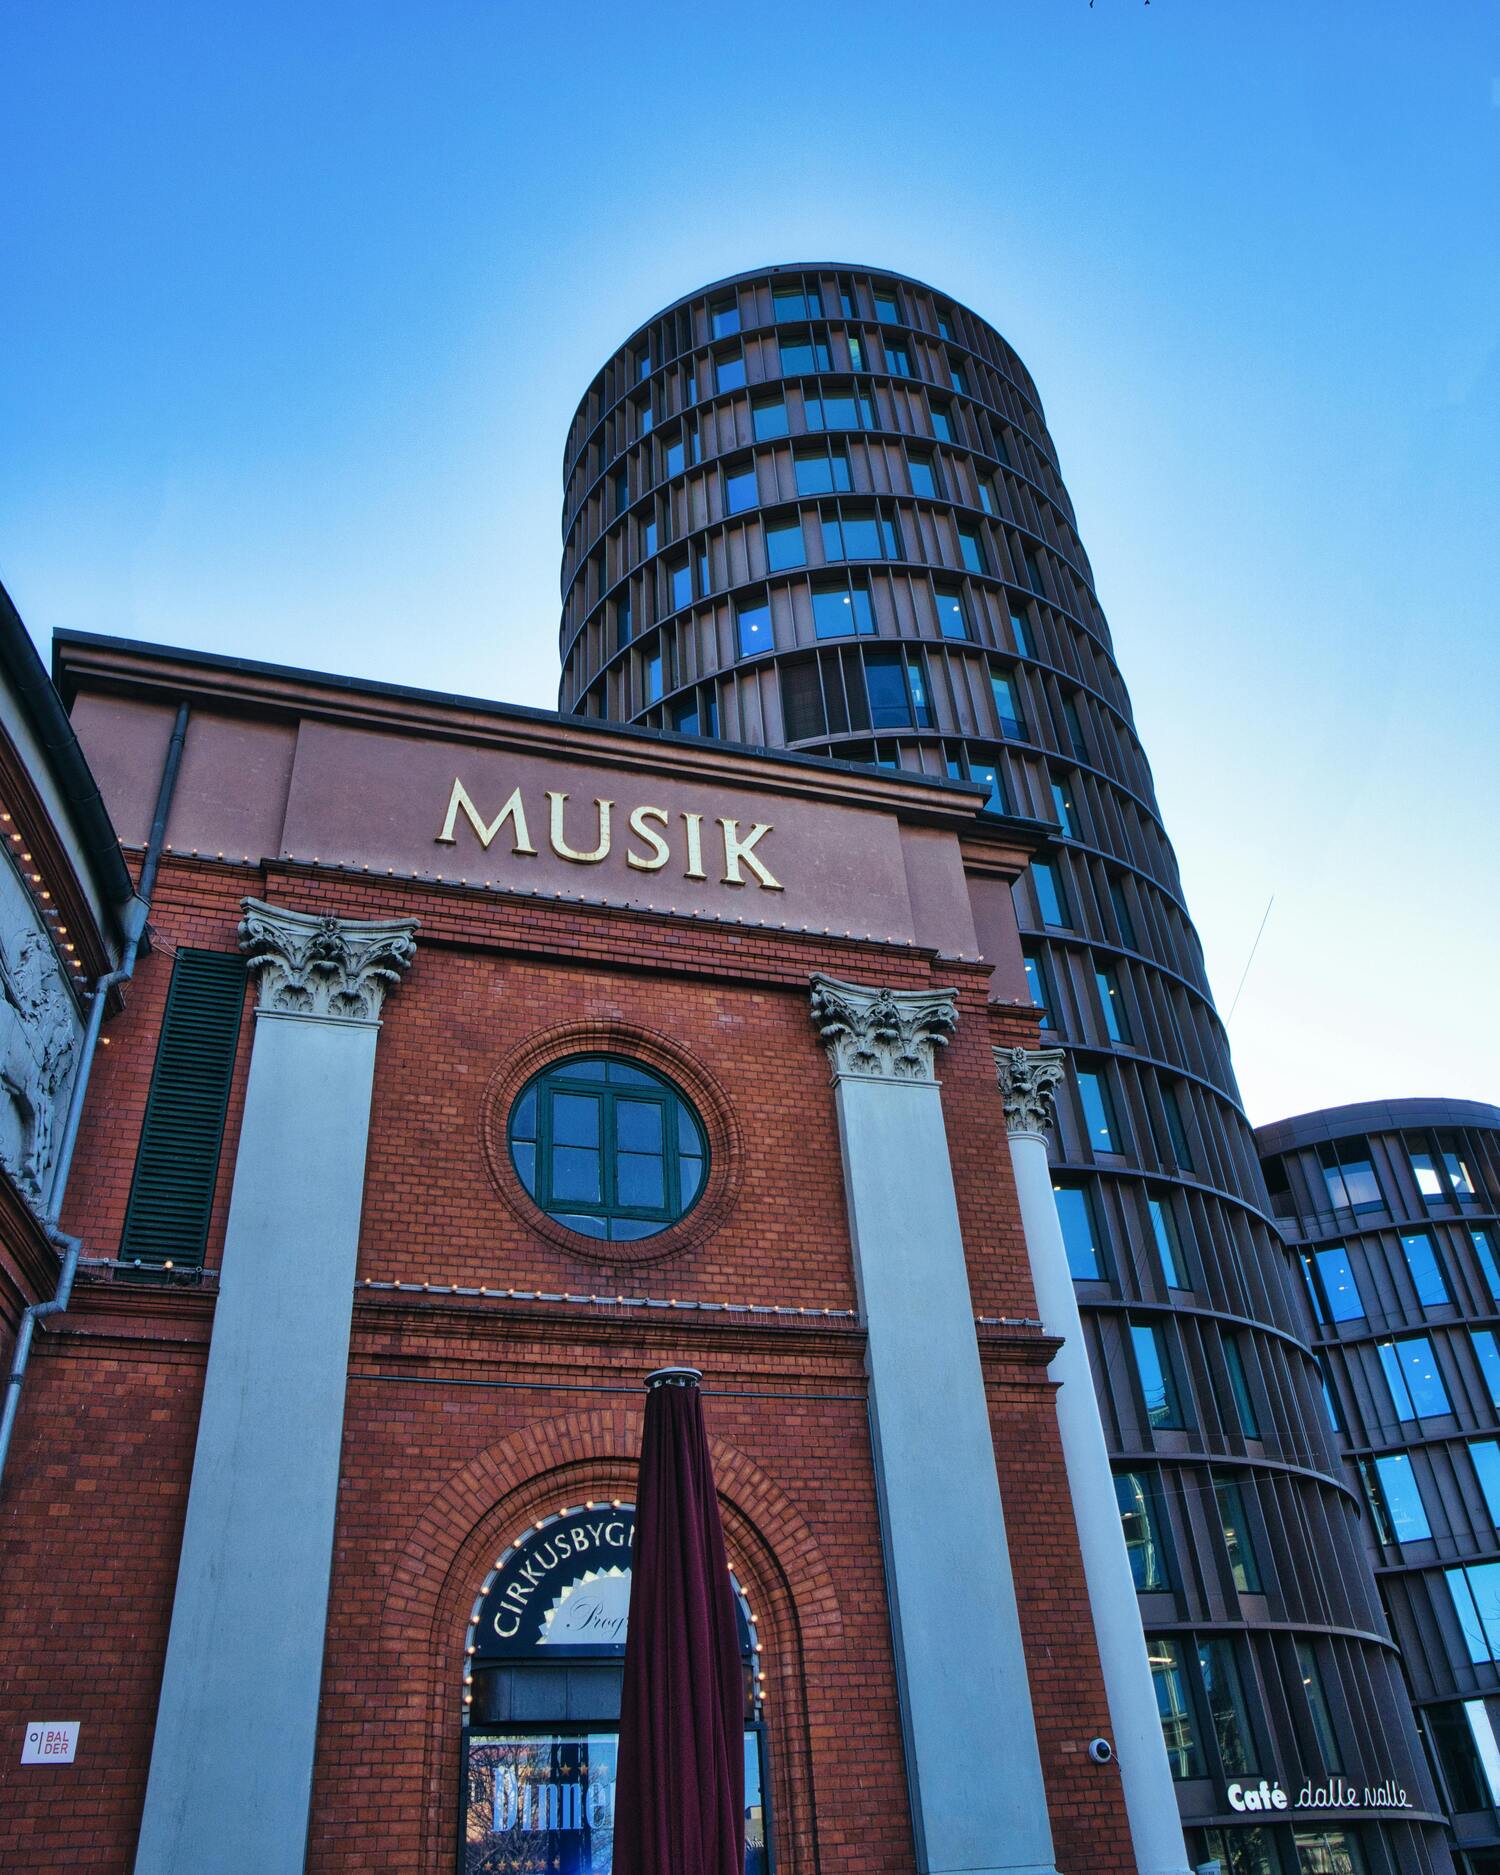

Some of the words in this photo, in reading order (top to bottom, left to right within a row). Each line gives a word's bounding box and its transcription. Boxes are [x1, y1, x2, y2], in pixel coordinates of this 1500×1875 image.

[435, 777, 785, 890] MUSIK
[566, 1597, 629, 1640] Prog
[44, 1743, 69, 1754] DER
[46, 1731, 69, 1742] BAL
[1227, 1781, 1288, 1812] Café
[1294, 1779, 1360, 1808] dalle
[1363, 1779, 1413, 1808] valle
